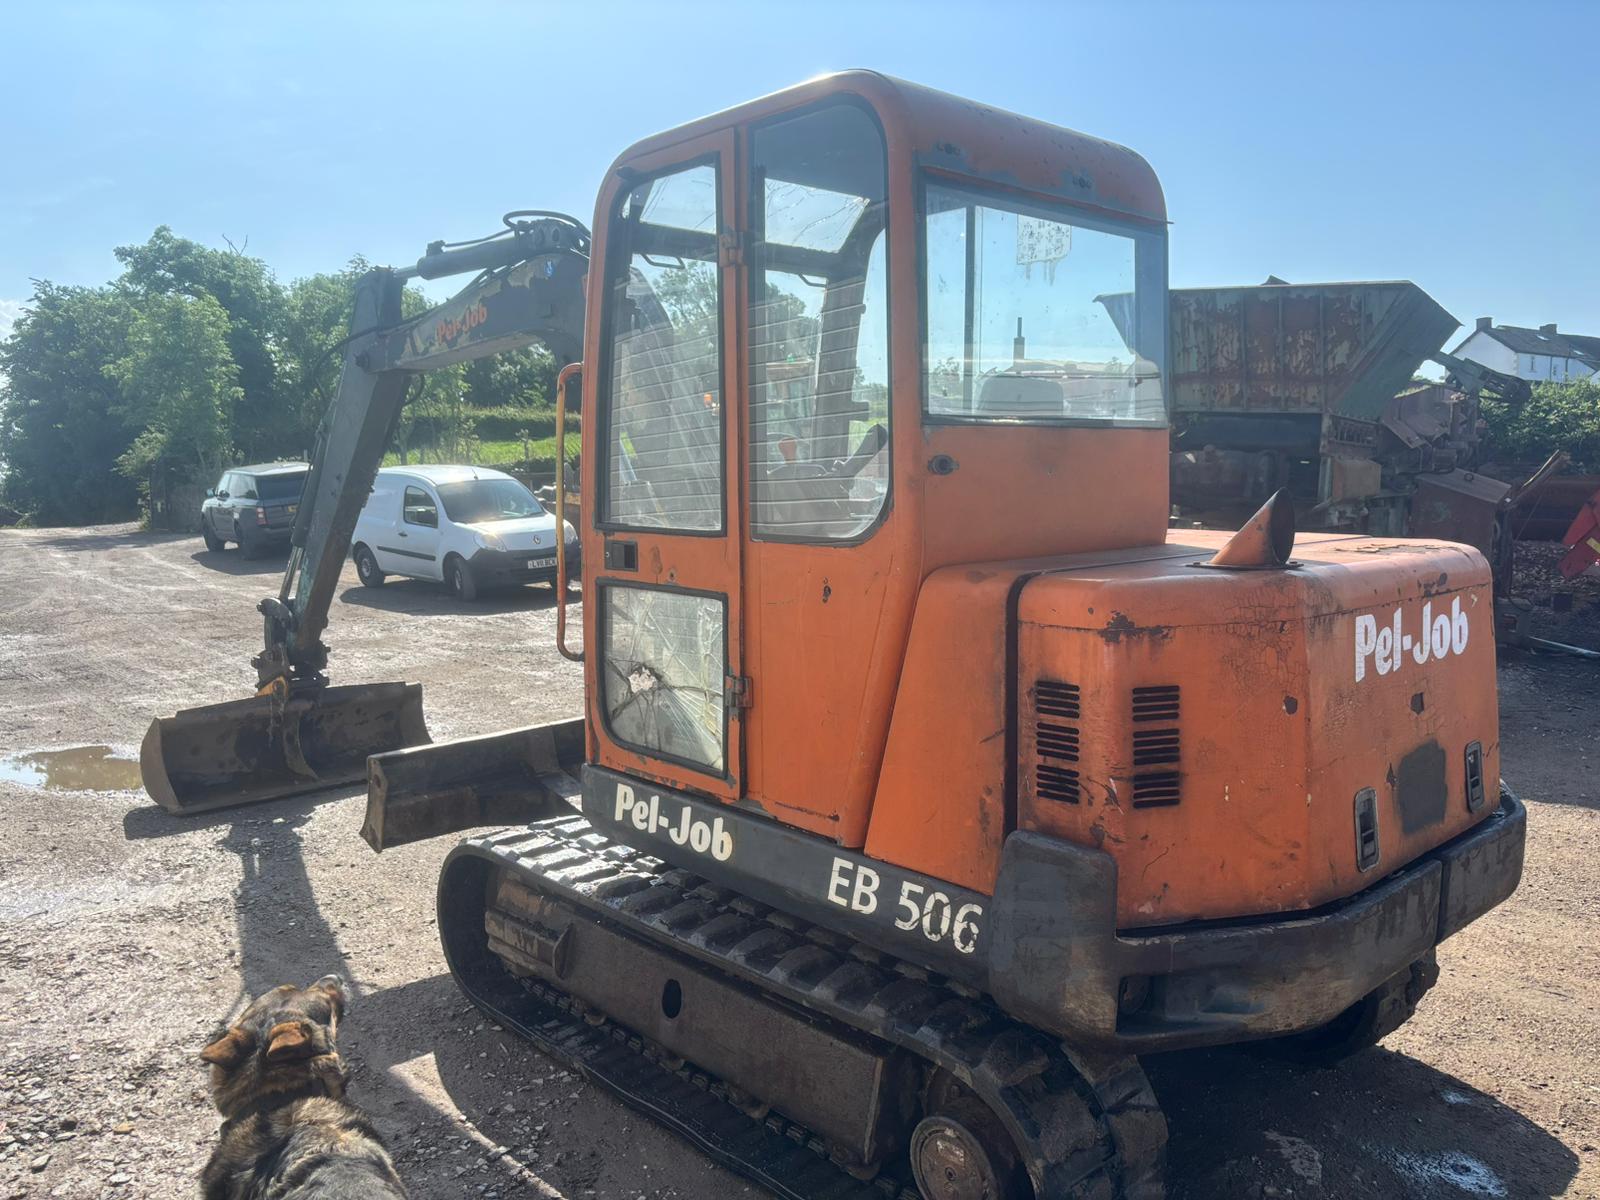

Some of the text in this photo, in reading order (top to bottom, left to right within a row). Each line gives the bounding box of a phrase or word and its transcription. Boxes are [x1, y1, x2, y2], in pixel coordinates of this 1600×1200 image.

[1355, 595, 1469, 683] Pel-Job
[614, 782, 733, 861] Pel-Job
[827, 856, 983, 954] EB 506
